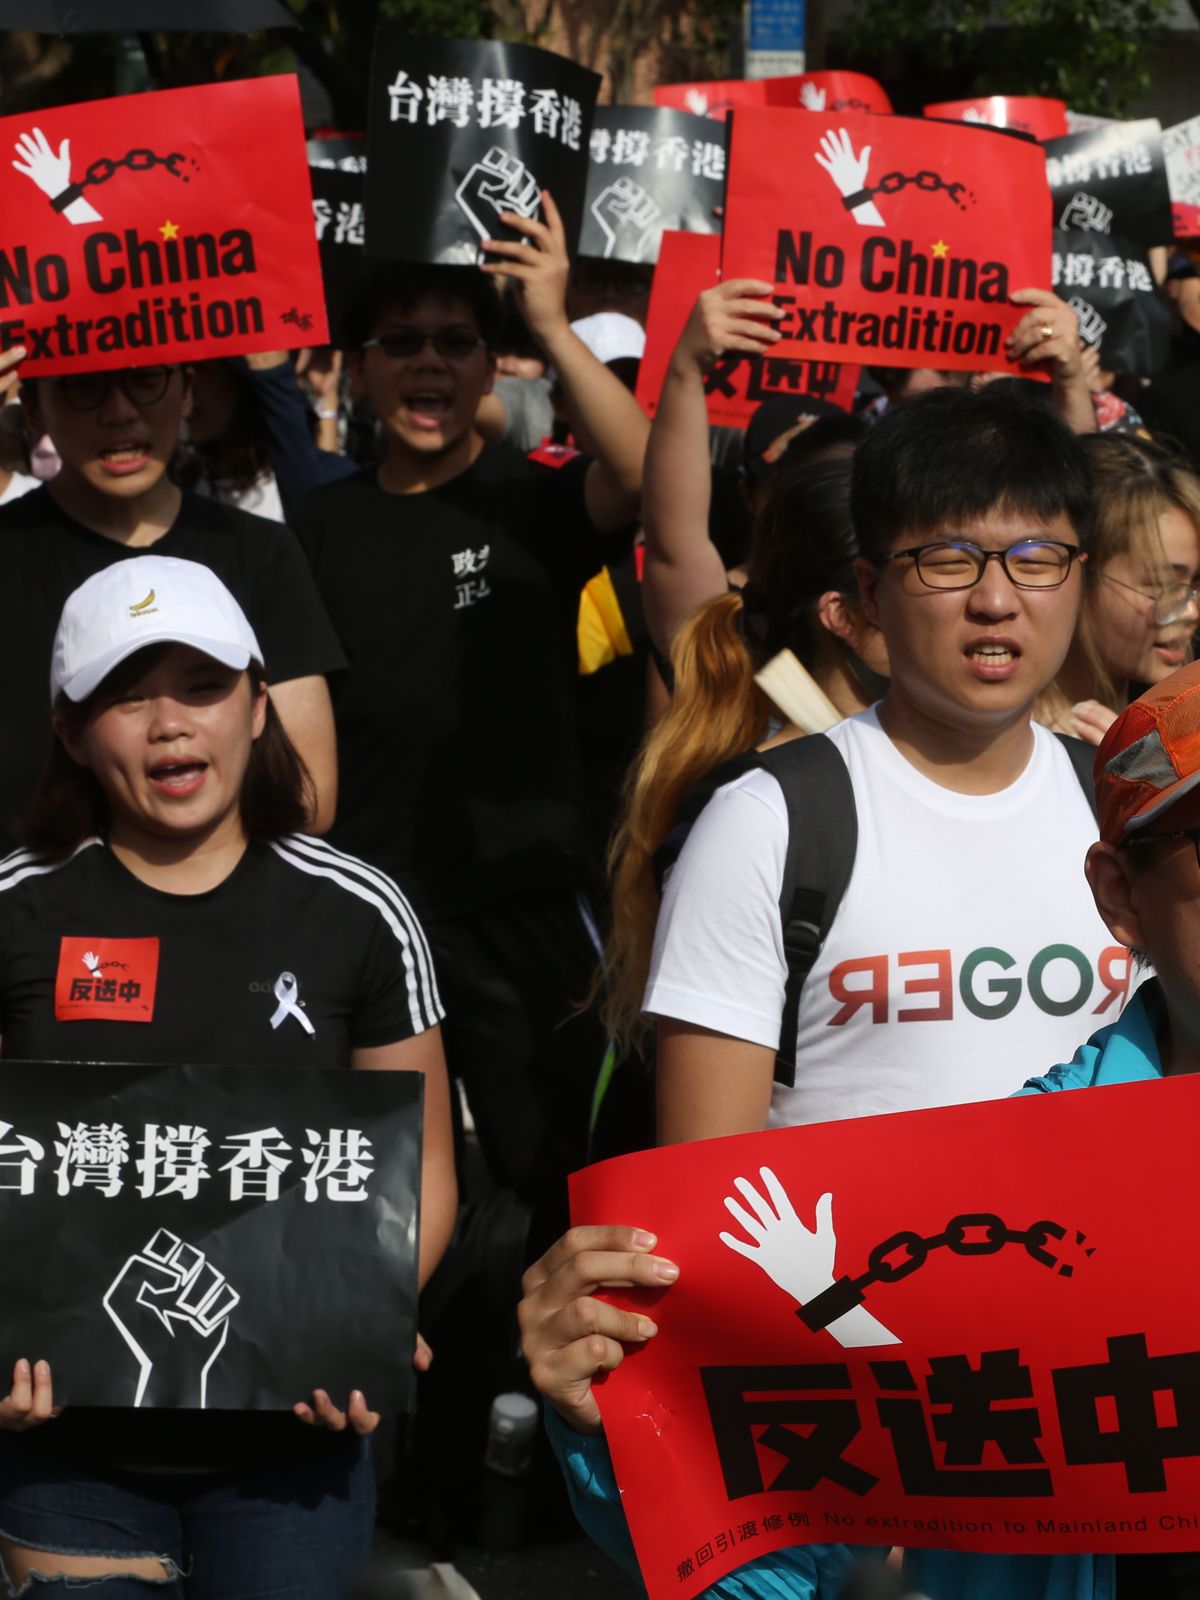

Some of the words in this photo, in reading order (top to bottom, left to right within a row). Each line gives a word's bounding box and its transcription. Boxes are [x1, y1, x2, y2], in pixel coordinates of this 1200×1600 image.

[387, 70, 582, 151] 台灣撐香港
[0, 245, 71, 309] No
[84, 228, 257, 295] China
[775, 229, 846, 290] No
[860, 235, 1010, 304] China
[0, 293, 266, 362] Extradition
[769, 295, 1003, 356] Extradition
[70, 978, 141, 1003] 反送中
[0, 1120, 375, 1203] 台灣撐香港
[675, 1511, 810, 1583] 撤回引渡修例
[824, 1512, 855, 1527] No
[865, 1515, 993, 1533] extradition
[1004, 1519, 1026, 1534] to
[1036, 1516, 1148, 1534] Mainland
